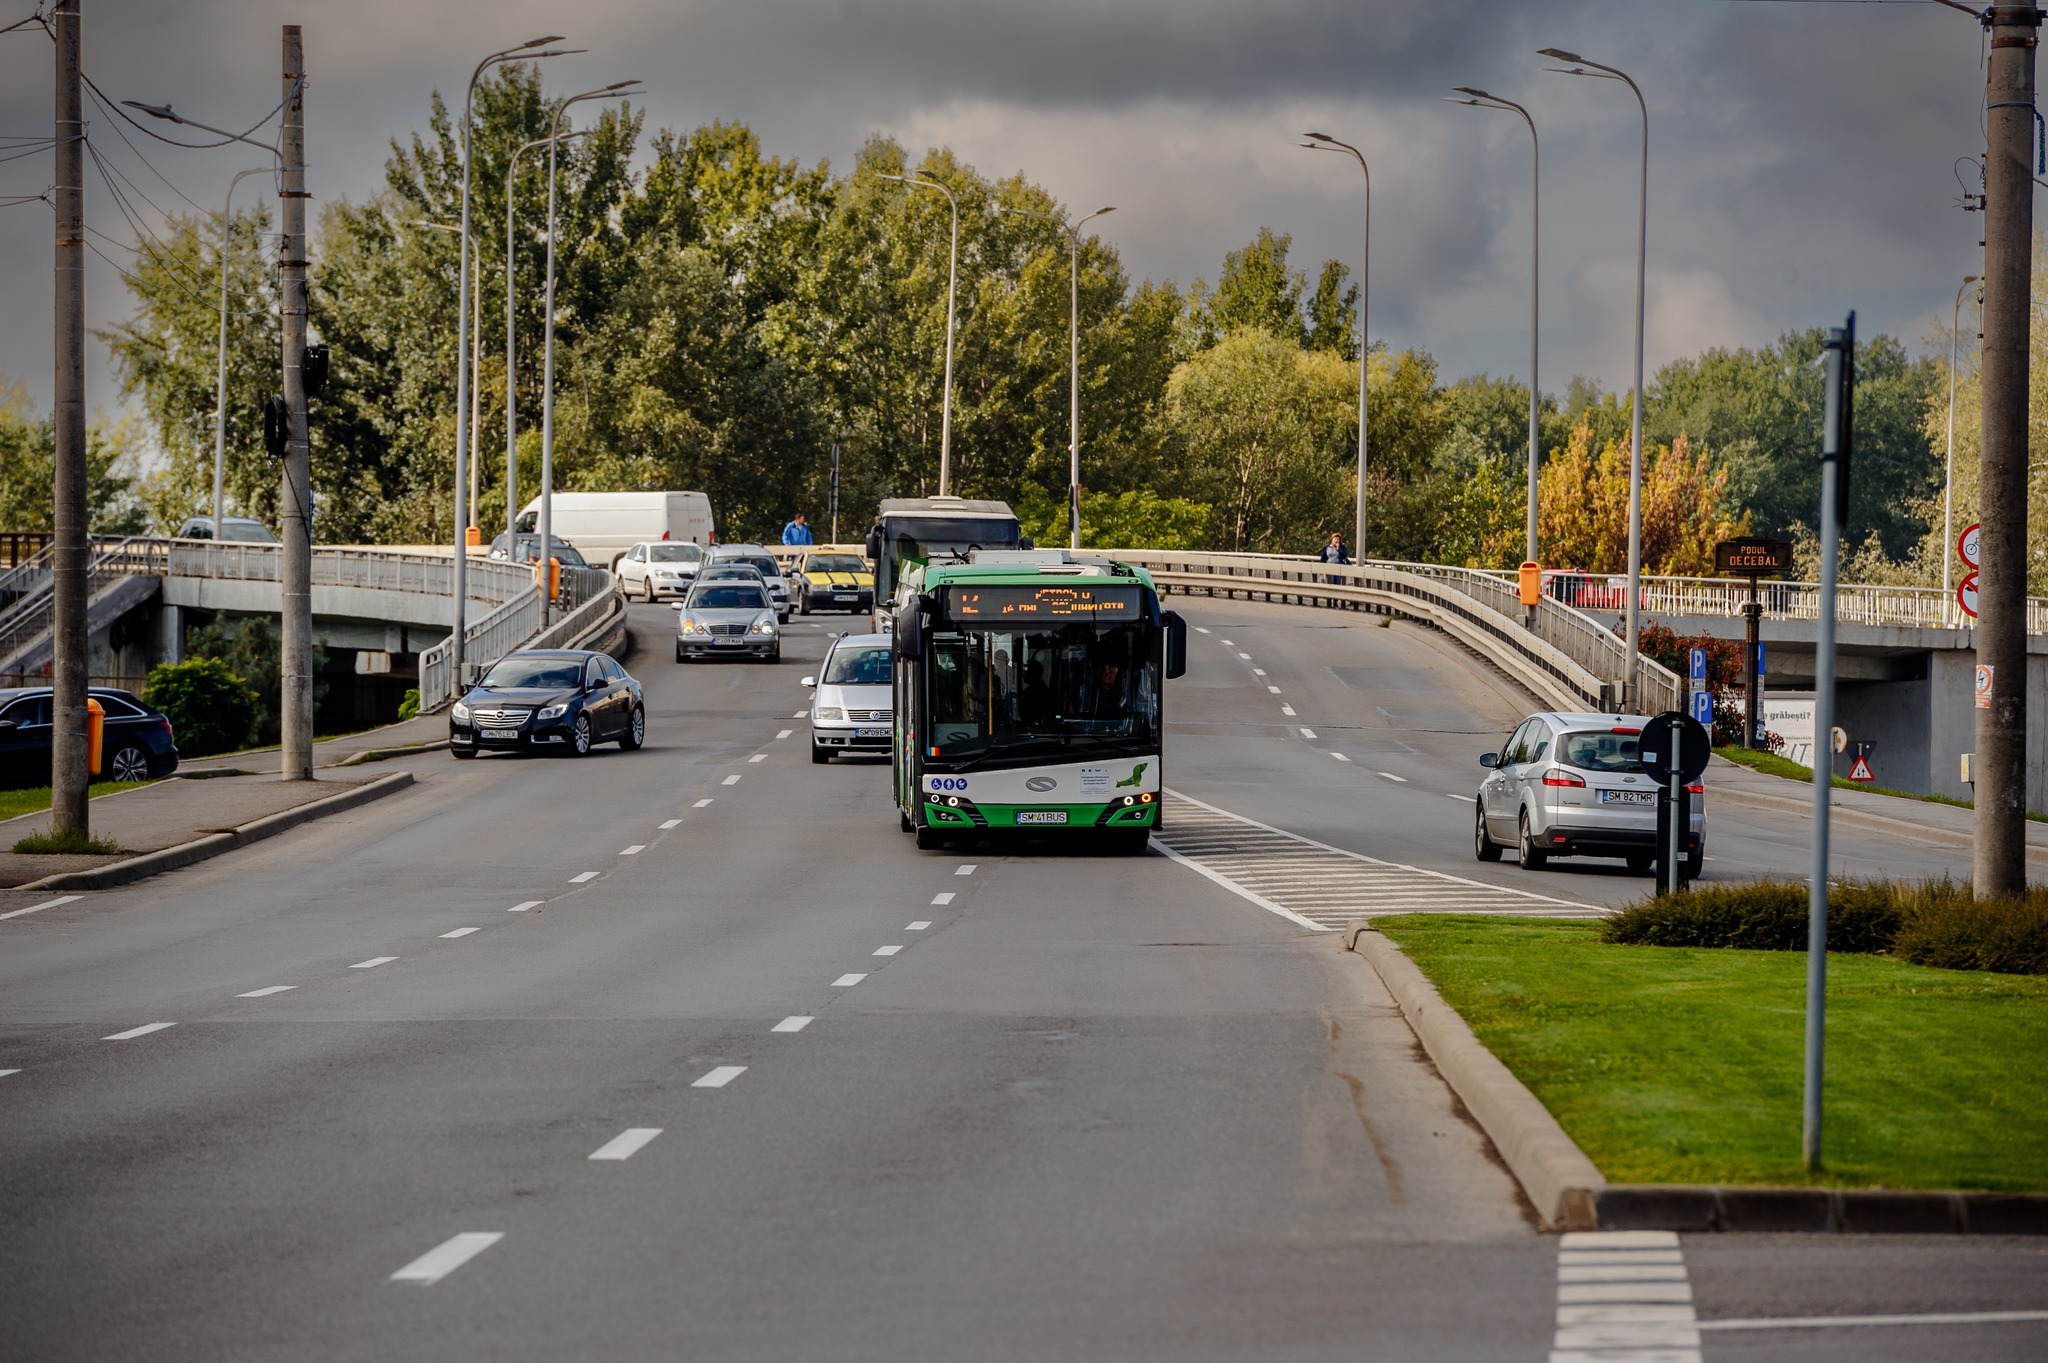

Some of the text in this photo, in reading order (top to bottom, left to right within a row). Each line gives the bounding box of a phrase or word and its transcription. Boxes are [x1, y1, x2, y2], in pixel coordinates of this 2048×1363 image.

[1740, 546, 1767, 554] PODUL
[1729, 556, 1778, 566] DECEBAL
[1694, 650, 1703, 677] P
[1698, 694, 1708, 722] P
[1608, 792, 1652, 802] SM 82 TMR
[1022, 813, 1065, 821] SM 41 BUS
